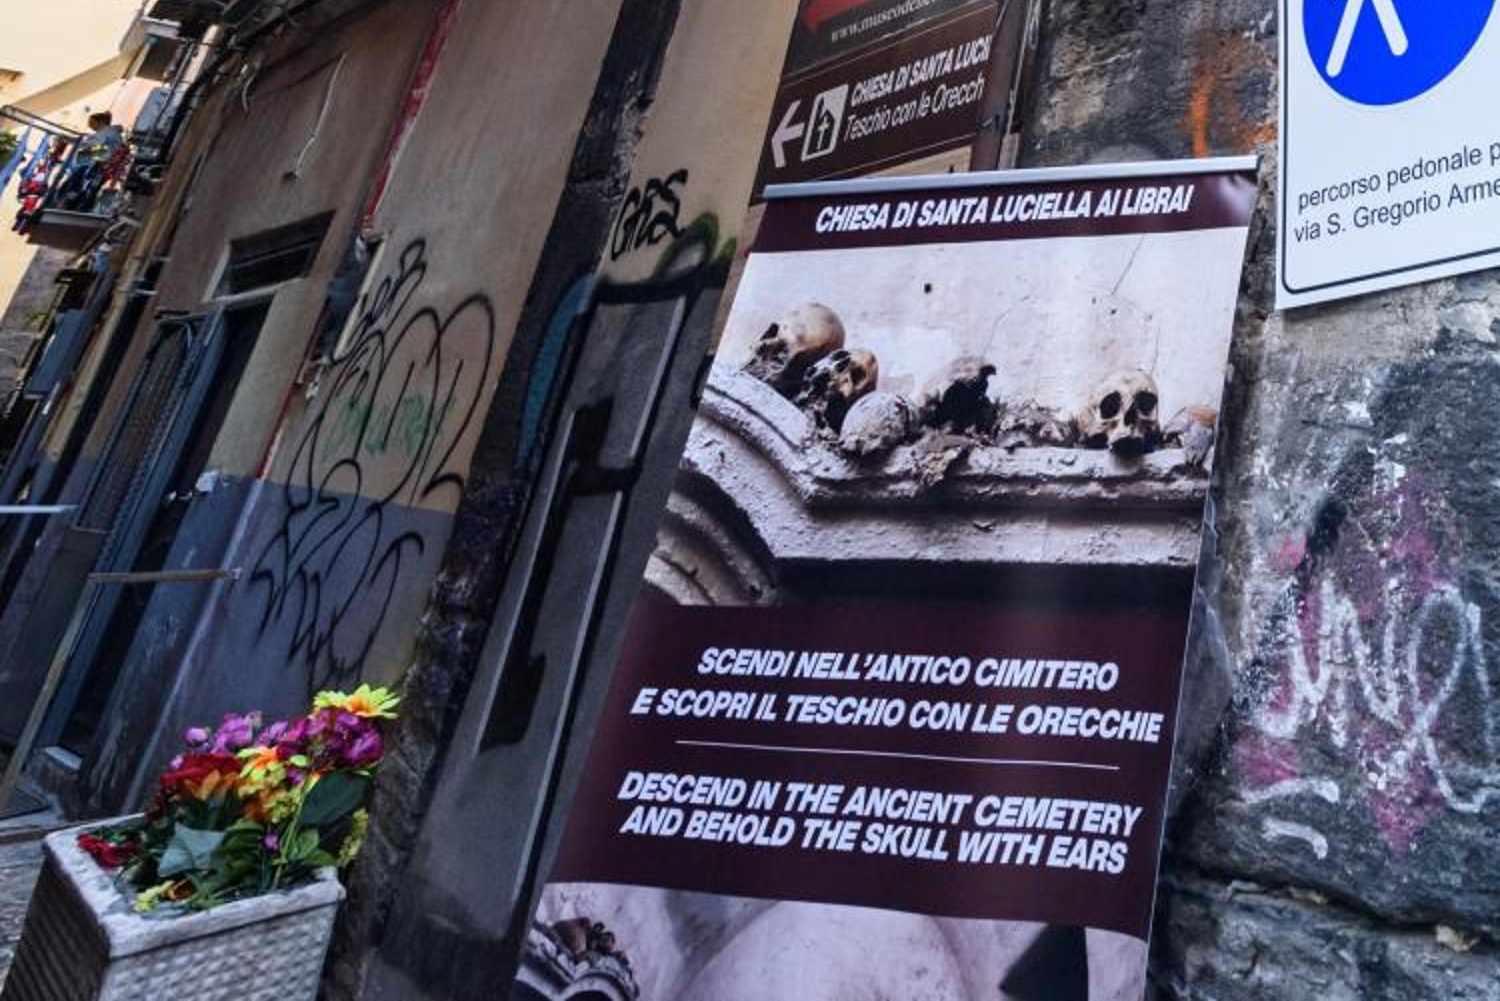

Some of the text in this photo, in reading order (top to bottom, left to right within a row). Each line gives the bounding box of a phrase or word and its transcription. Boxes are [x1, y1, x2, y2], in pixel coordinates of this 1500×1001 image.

[851, 71, 896, 107] CHIESA
[893, 63, 912, 91] DI
[909, 47, 953, 85] SANTA
[843, 102, 891, 143] Teschio
[891, 99, 918, 128] con
[916, 91, 932, 120] le
[815, 183, 1195, 234] CHIESA DI SANTA LUCIELLA AI LIBRAI
[1297, 173, 1381, 216] percorso
[1386, 145, 1483, 192] pedonale
[1294, 219, 1321, 243] via
[1327, 212, 1346, 236] S.
[1353, 191, 1441, 226] Gregorio
[698, 647, 1119, 692] SCENDI NELL'ANTICO CIMITERO
[629, 687, 1165, 743] E SCOPRI IL TESCHIO CON LE ORECCHIE
[617, 770, 1144, 838] DESCEND IN THE ANCIENT CEMETERY
[619, 805, 1129, 875] AND BEHOLD THE SKULL WITH EARS
